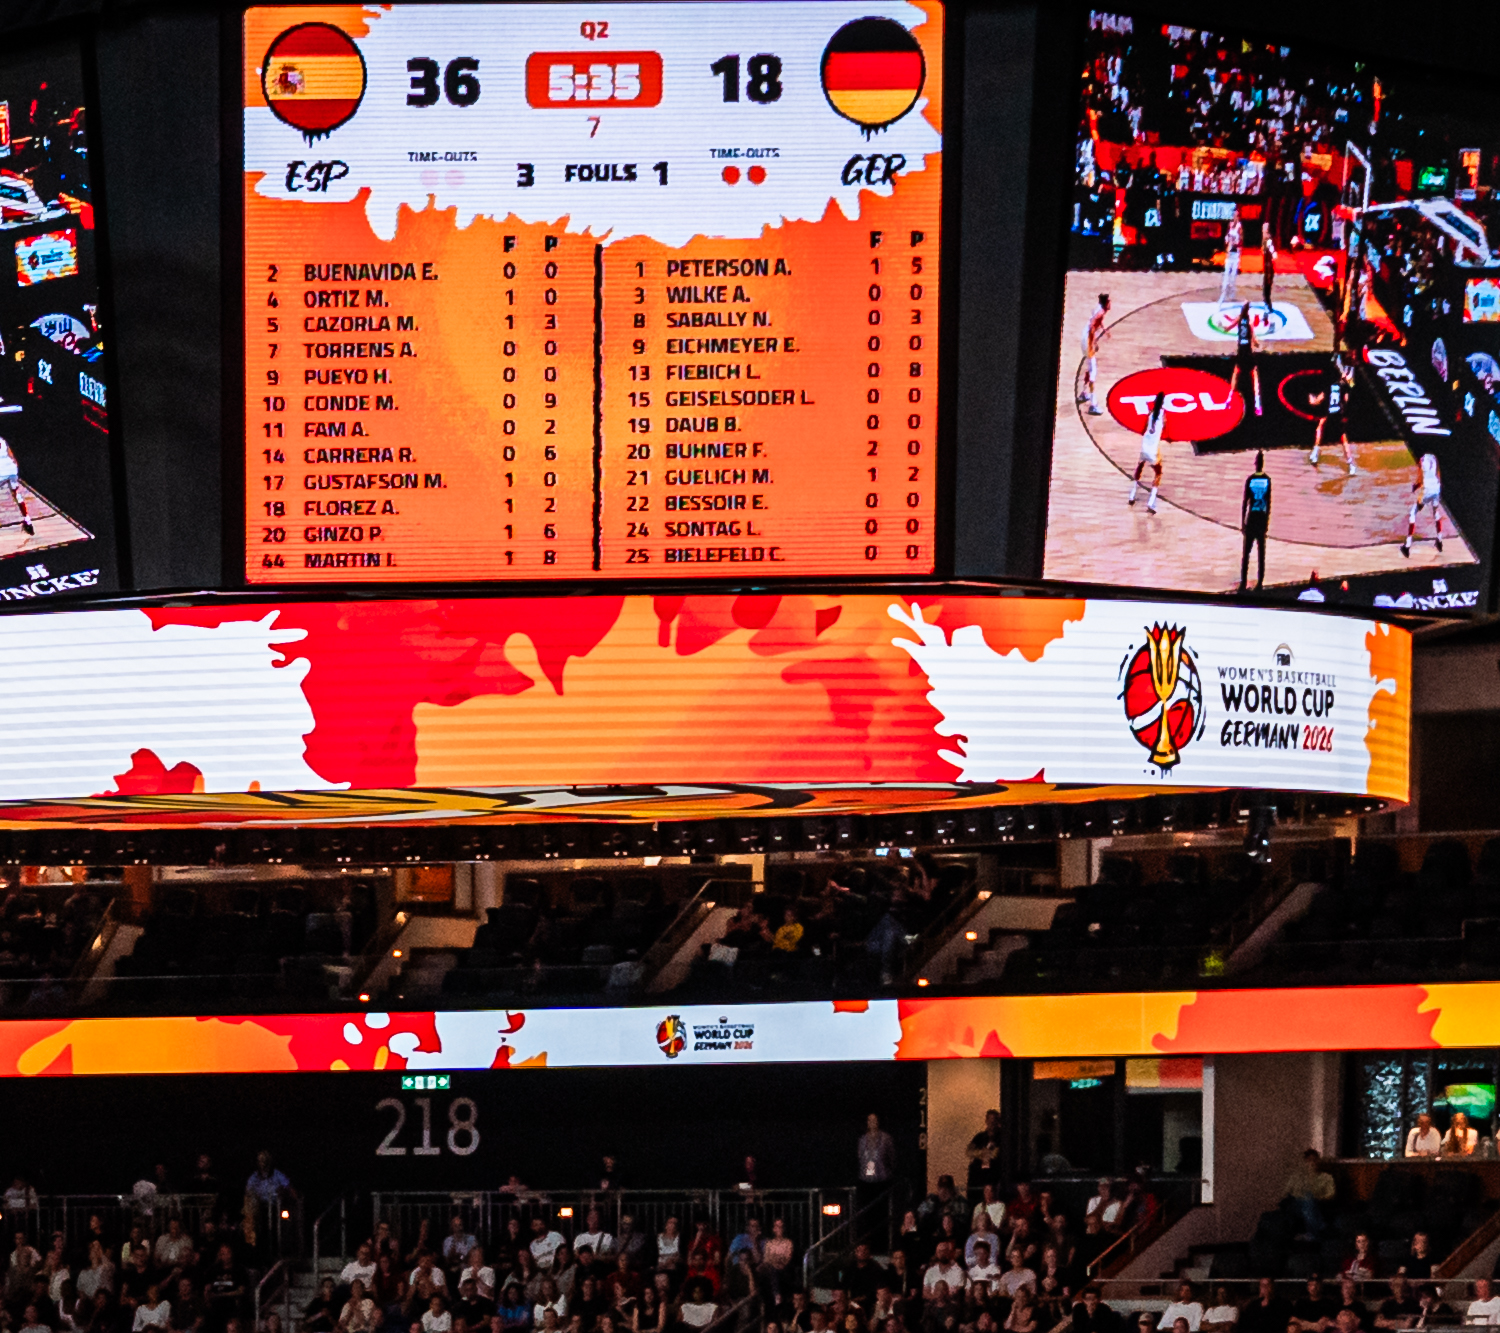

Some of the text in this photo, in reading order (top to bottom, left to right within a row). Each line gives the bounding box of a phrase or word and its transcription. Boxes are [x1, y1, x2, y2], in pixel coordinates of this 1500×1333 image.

[580, 21, 608, 41] Q2
[406, 56, 480, 107] 36
[549, 61, 640, 100] 5:35
[711, 54, 782, 104] 18
[588, 117, 600, 139] 7
[408, 151, 477, 163] TIME-OUTS
[710, 148, 780, 160] TIME-OUTS
[285, 160, 349, 192] ESP
[517, 162, 669, 187] 3 FOULS 1
[841, 154, 906, 187] GER
[504, 235, 557, 254] F P
[871, 231, 923, 249] F P
[305, 263, 416, 281] BUENAVIDA
[667, 259, 767, 277] PETERSON
[305, 290, 359, 307] ORTIZ
[667, 286, 725, 303] WILKE
[305, 317, 390, 332] CAZORLA
[667, 312, 746, 327] SABALLY
[304, 343, 394, 358] TORRENS
[667, 338, 777, 353] EICHMEYER
[305, 370, 367, 384] PUEYO
[667, 365, 740, 380] FIEBICH
[666, 390, 795, 406] GEISELSODER
[1367, 349, 1451, 435] BERLIN
[305, 396, 369, 410] CONDE
[1120, 392, 1232, 415] TCL
[305, 422, 345, 436] FAM
[667, 418, 718, 432] DAUB
[304, 448, 393, 463] CARRERA
[666, 443, 747, 458] BUHNER
[305, 474, 418, 489] GUSTAFSON
[666, 470, 745, 485] GUELICH
[305, 501, 376, 515] FLOREZ
[666, 495, 745, 510] BESSOIR
[305, 527, 363, 542] GINZO
[665, 522, 740, 536] SONTAG
[305, 553, 380, 567] MARTIN
[666, 548, 764, 562] BIELEFELD
[1217, 666, 1337, 688] WOMEN'S BASKETBALL
[1220, 683, 1335, 717] WORLD CUP
[1220, 719, 1335, 752] GERMANY 2026
[375, 1097, 480, 1155] 218
